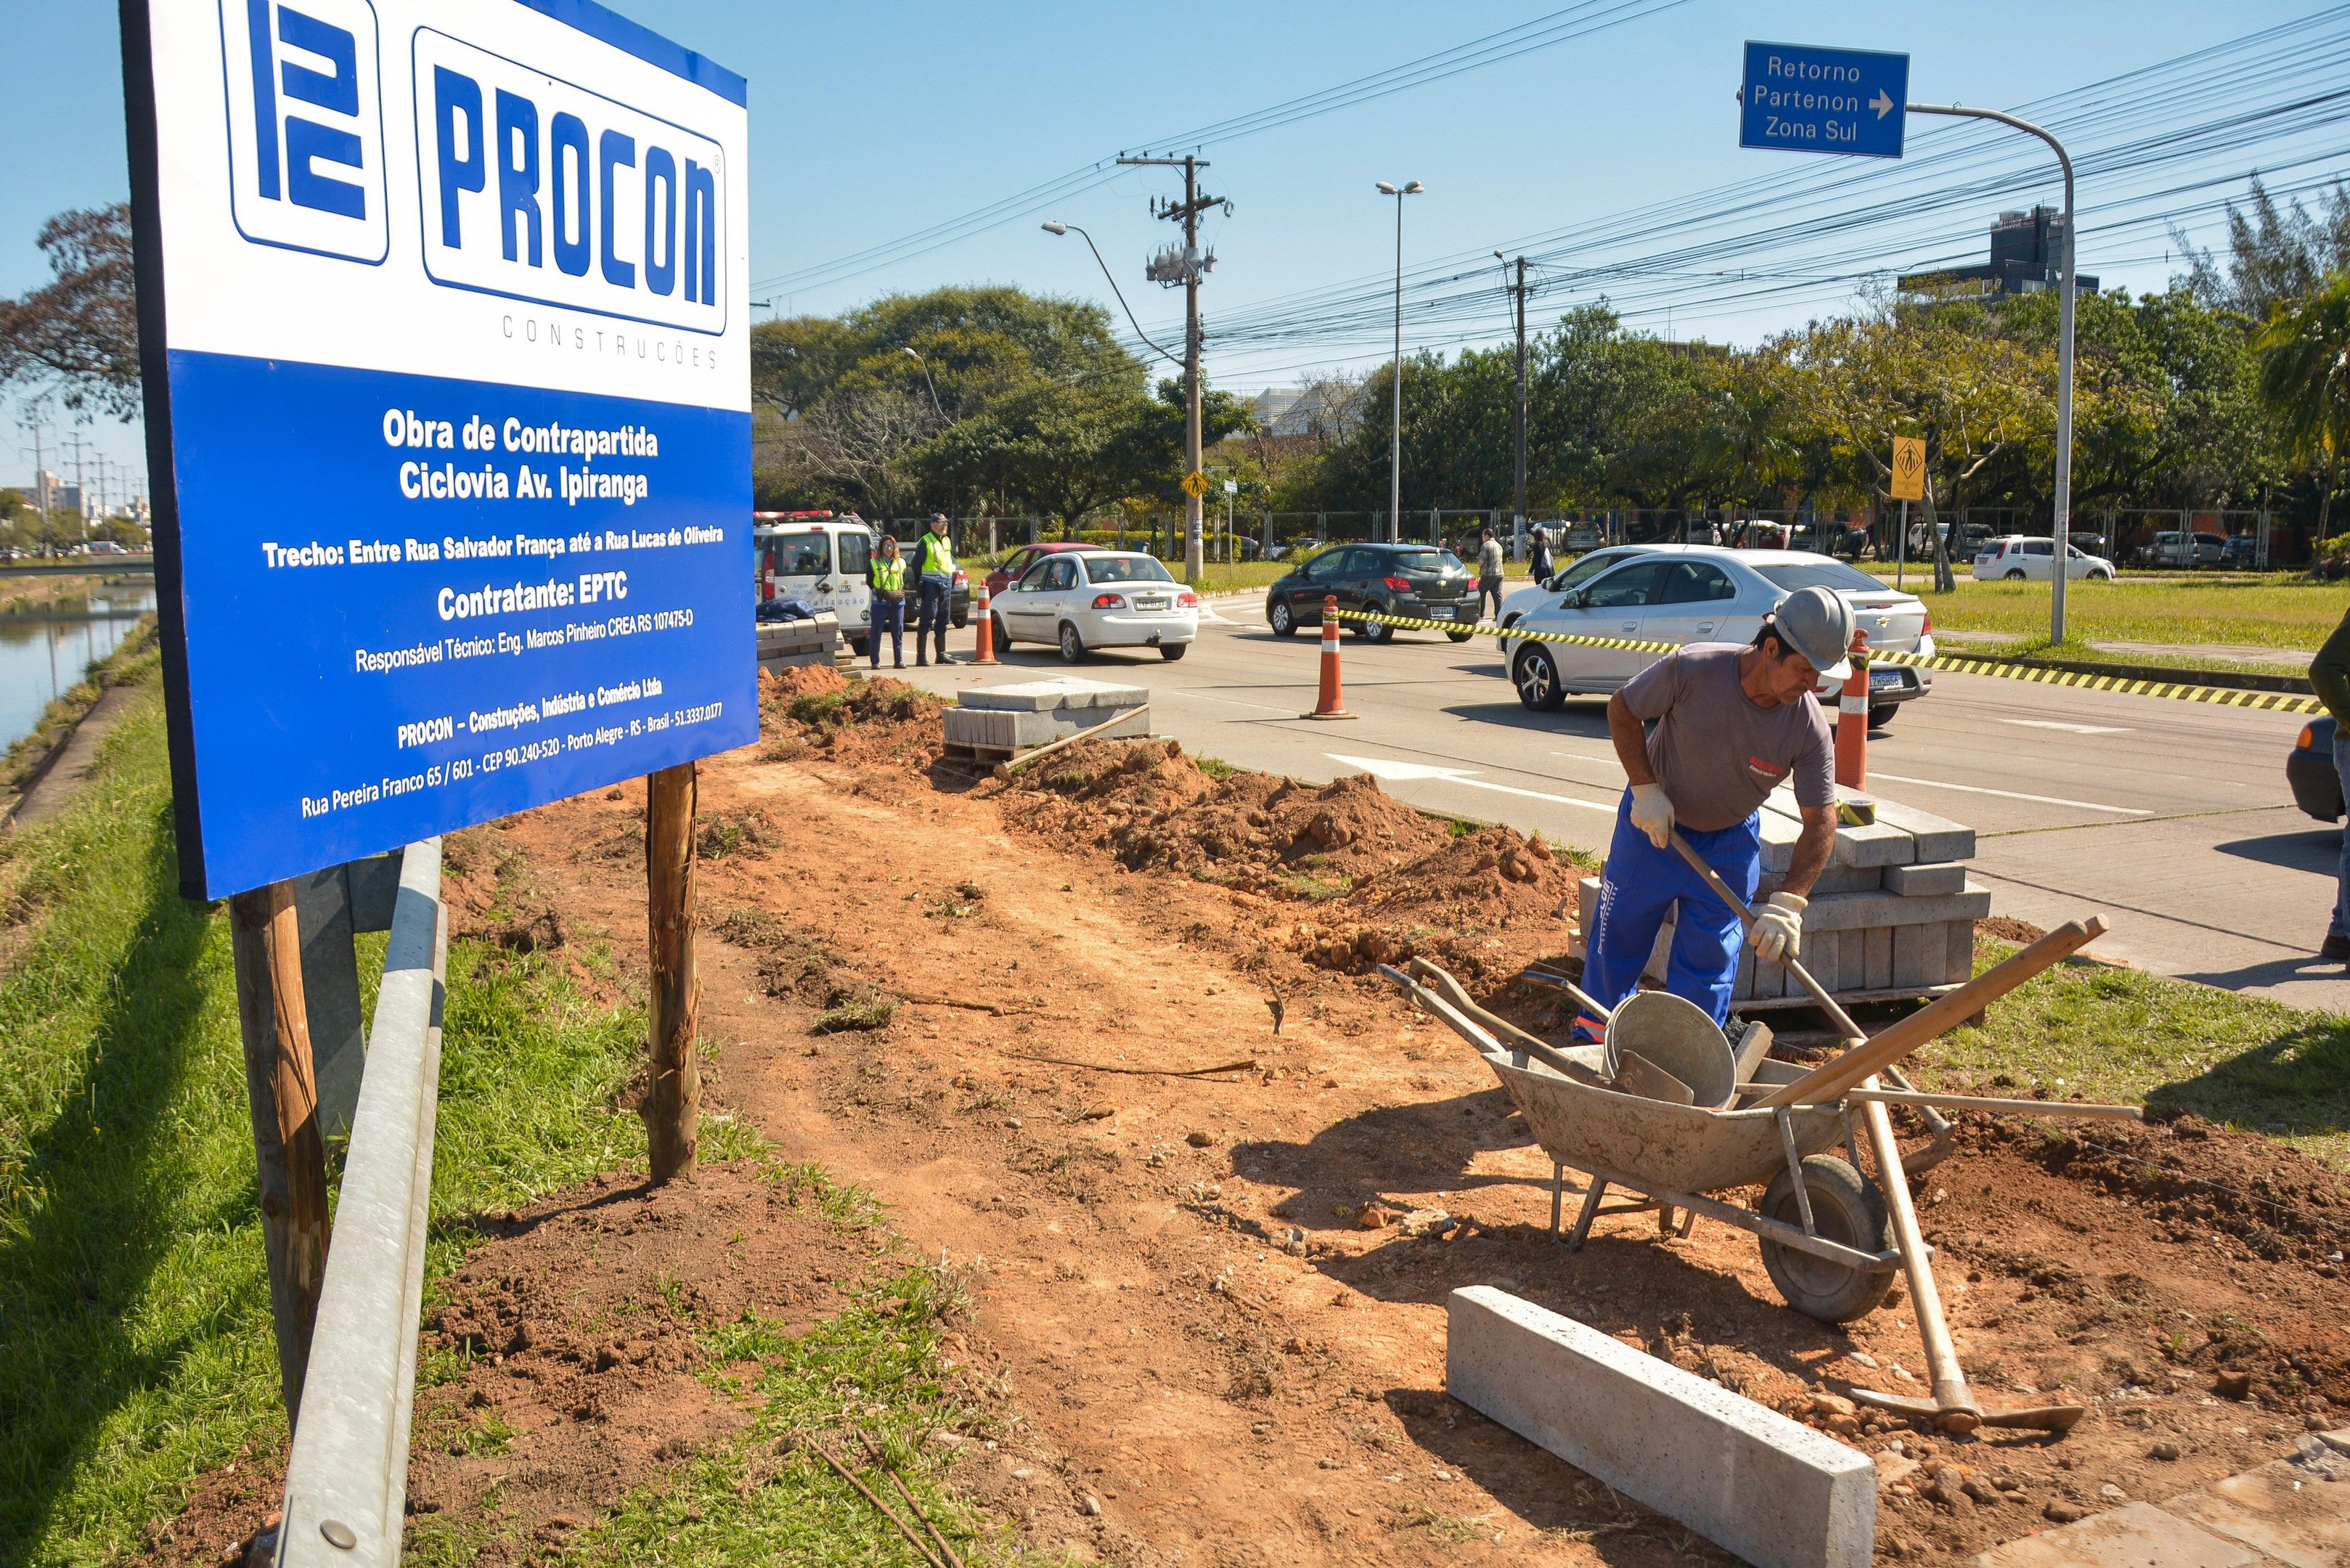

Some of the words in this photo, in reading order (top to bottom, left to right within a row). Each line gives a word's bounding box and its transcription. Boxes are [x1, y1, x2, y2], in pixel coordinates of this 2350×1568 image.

[1768, 56, 1860, 82] Retorno
[1755, 85, 1859, 112] Partenon
[1766, 115, 1816, 139] Zona
[1825, 120, 1857, 142] Sul
[503, 315, 716, 369] CONSTRUÇÕES
[383, 408, 454, 449] Obra
[462, 415, 496, 451] de
[503, 417, 658, 462] Contrapartida
[399, 461, 510, 499] Ciclovia
[515, 465, 552, 499] Av.
[560, 465, 648, 506] Ipiranga
[261, 541, 345, 568] Trecho:
[348, 539, 401, 564] Entre
[404, 538, 440, 562] Rua
[443, 535, 513, 560] Salvador
[515, 534, 566, 560] França
[568, 531, 592, 553] até
[594, 535, 603, 552] a
[605, 530, 629, 550] Rua
[632, 529, 667, 549] Lucas
[667, 527, 682, 547] de
[683, 524, 724, 545] Oliveira
[437, 577, 575, 621] Contratante:
[579, 570, 628, 604] EPTC
[355, 640, 443, 674] Responsável
[444, 635, 496, 660] Técnico:
[497, 632, 524, 656] Eng.
[526, 628, 565, 650] Marcos
[566, 620, 607, 643] Pinheiro
[607, 615, 637, 637] CREA
[637, 613, 653, 633] RS
[653, 608, 694, 630] 107475-D
[398, 715, 454, 749] PROCON
[469, 701, 540, 734] Construções,
[542, 690, 587, 718] Indústria
[587, 692, 595, 709] e
[597, 680, 641, 706] Comércio
[642, 676, 663, 698] Ltda
[301, 796, 329, 819] Rua
[332, 783, 380, 811] Pereira
[382, 774, 425, 798] Franco
[426, 765, 442, 787] 65
[452, 758, 474, 780] 601
[482, 751, 503, 773] CEP
[505, 737, 560, 768] 90.240-520
[567, 732, 594, 751] Porto
[595, 725, 624, 746] Alegre
[629, 719, 642, 737] RS
[647, 711, 670, 732] Brasil
[674, 701, 723, 727] 51.3337.0177
